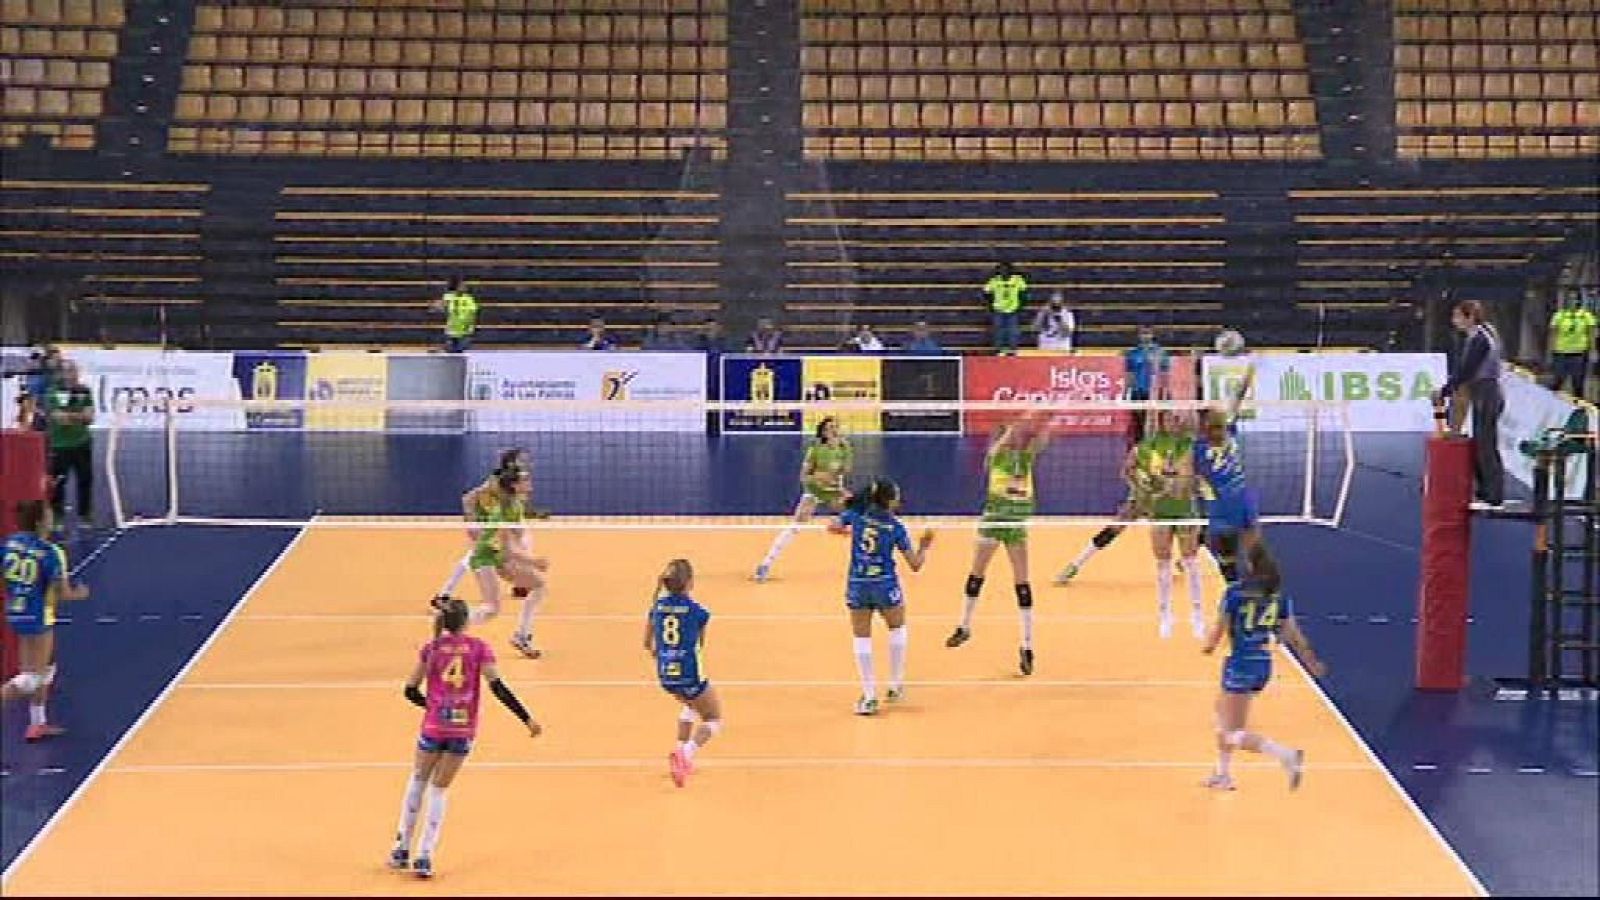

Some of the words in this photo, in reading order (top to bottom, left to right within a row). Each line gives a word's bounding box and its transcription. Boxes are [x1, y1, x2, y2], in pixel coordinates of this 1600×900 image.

[1051, 367, 1111, 390] Islas
[1323, 371, 1434, 402] IBSA
[861, 526, 879, 552] 5
[4, 551, 38, 585] 20
[663, 615, 681, 647] 8
[1239, 600, 1279, 631] 14
[441, 655, 466, 689] 4
